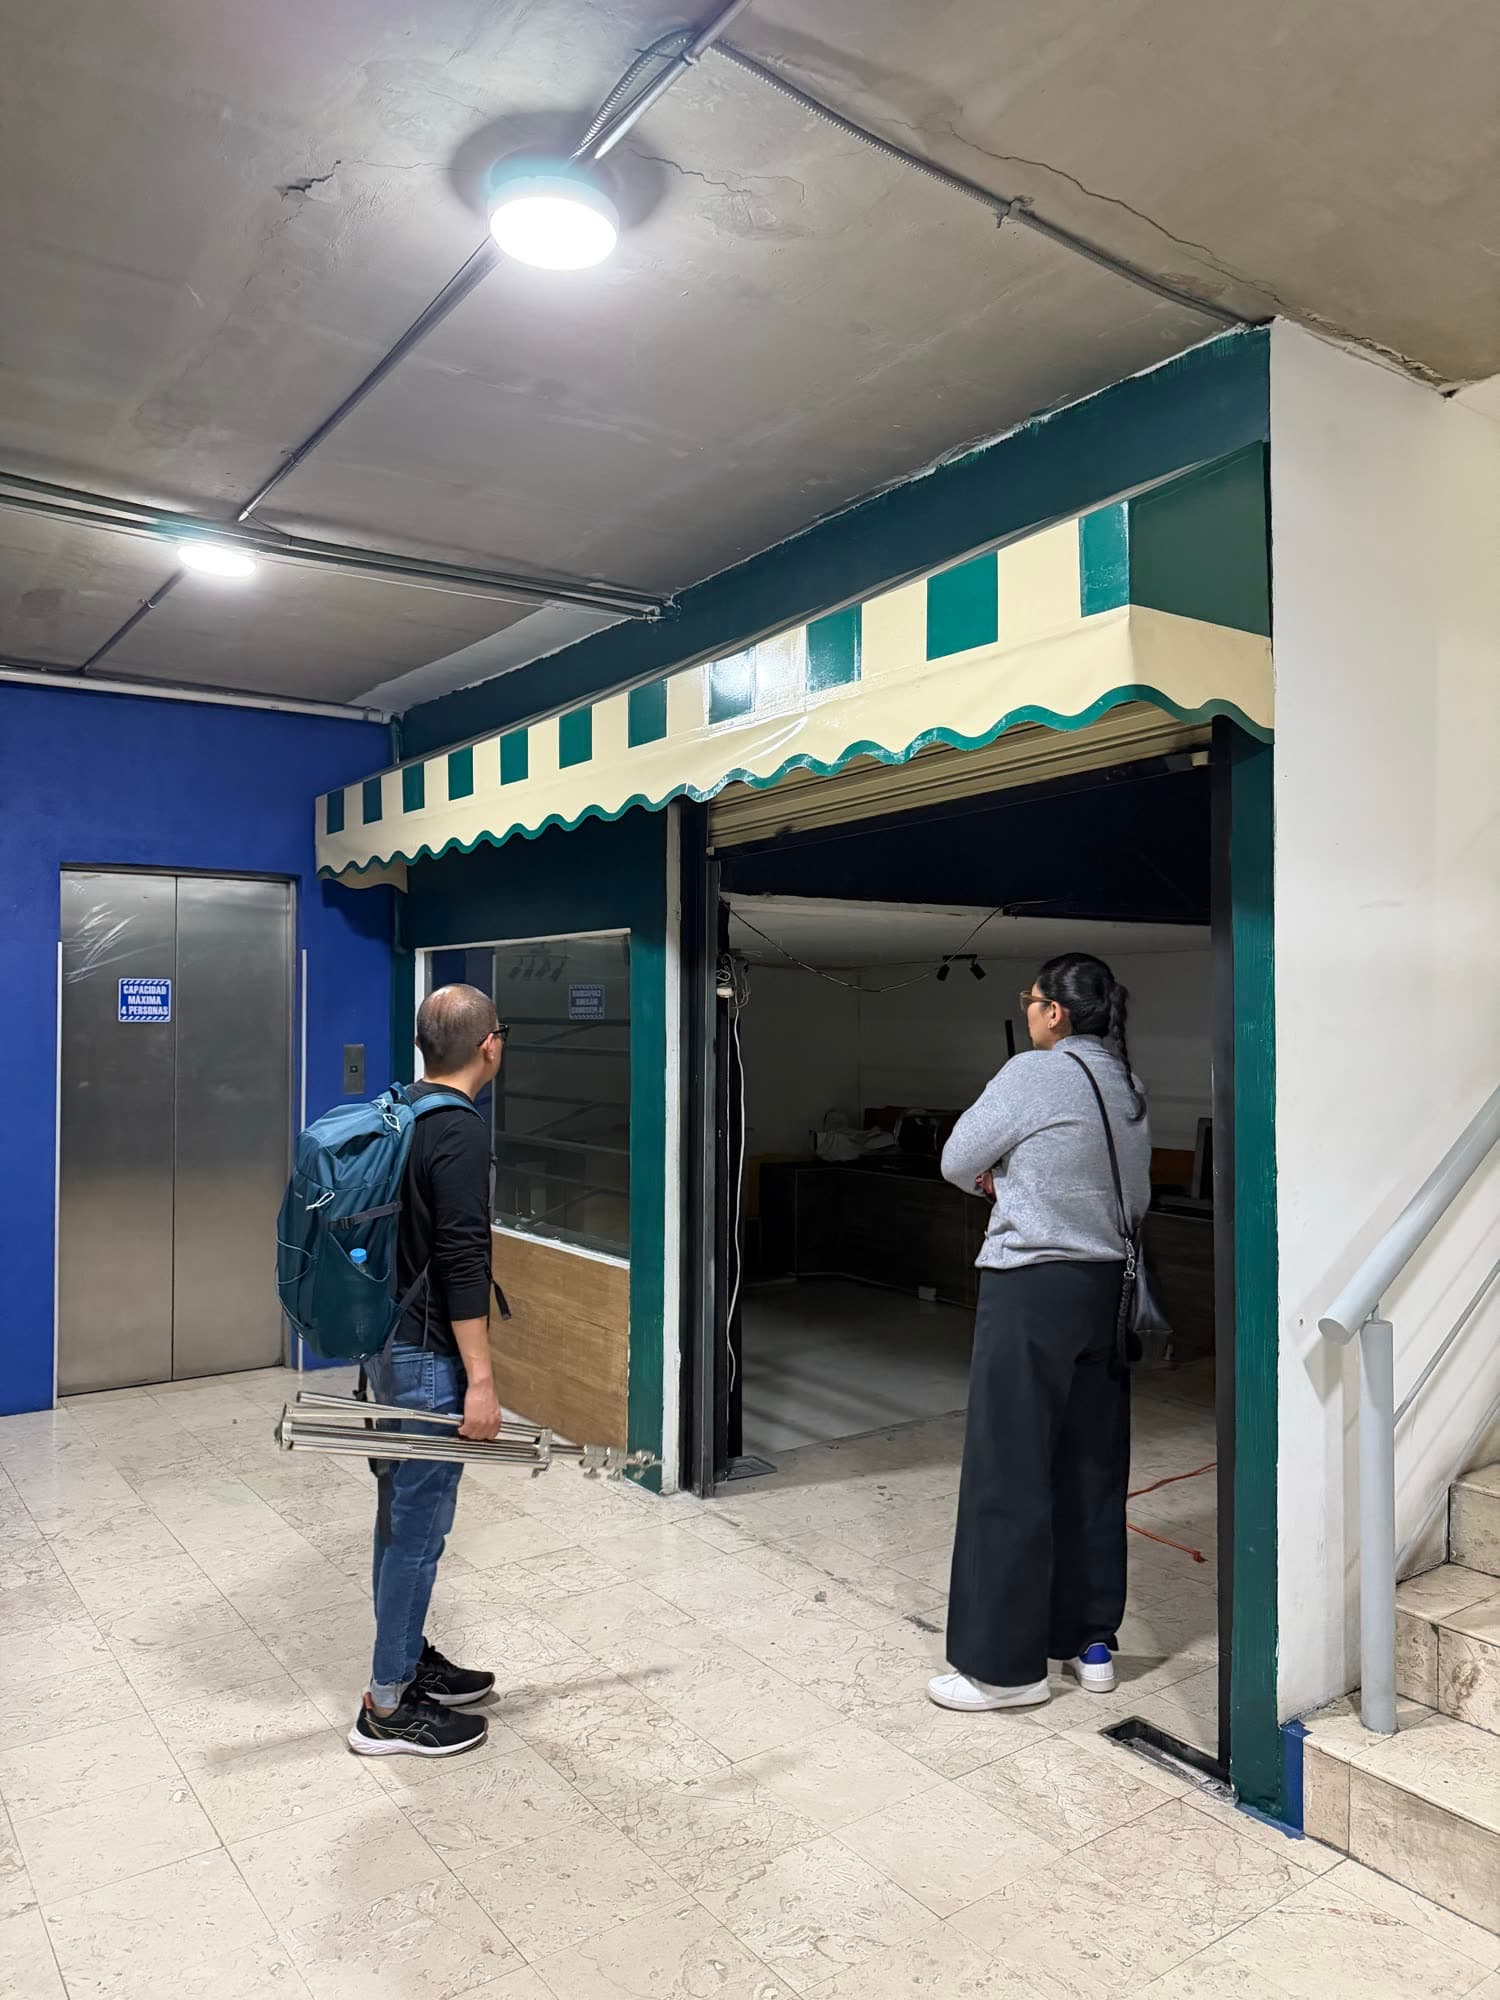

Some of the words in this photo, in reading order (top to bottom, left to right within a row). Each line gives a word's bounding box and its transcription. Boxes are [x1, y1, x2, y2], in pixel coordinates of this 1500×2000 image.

[123, 985, 167, 994] CAPACIDAD
[121, 1005, 127, 1014] 4
[128, 1006, 168, 1015] PERSONAS
